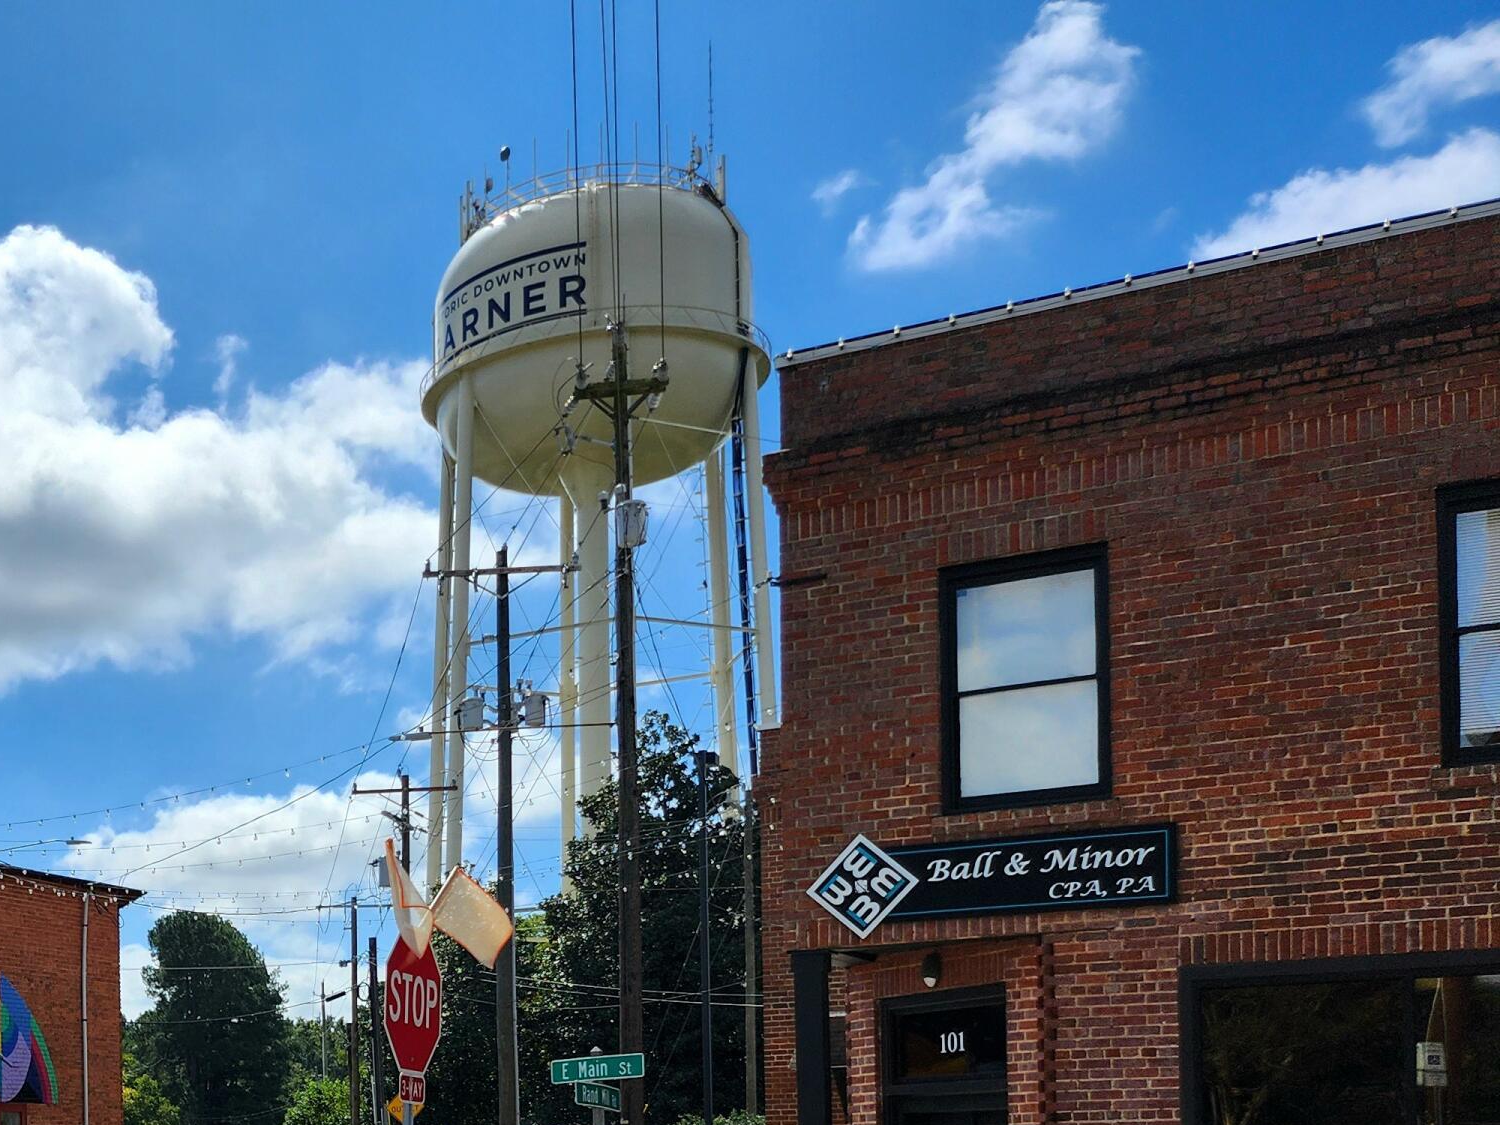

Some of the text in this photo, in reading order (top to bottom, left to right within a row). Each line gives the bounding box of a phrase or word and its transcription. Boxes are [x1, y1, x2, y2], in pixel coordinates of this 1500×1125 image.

[473, 253, 586, 298] DOWNTOWN
[926, 845, 1156, 882] Ball & Minor
[1048, 876, 1156, 899] CPA, PA
[389, 970, 438, 1029] STOP
[940, 1032, 965, 1053] 101
[562, 1060, 632, 1080] E Main St
